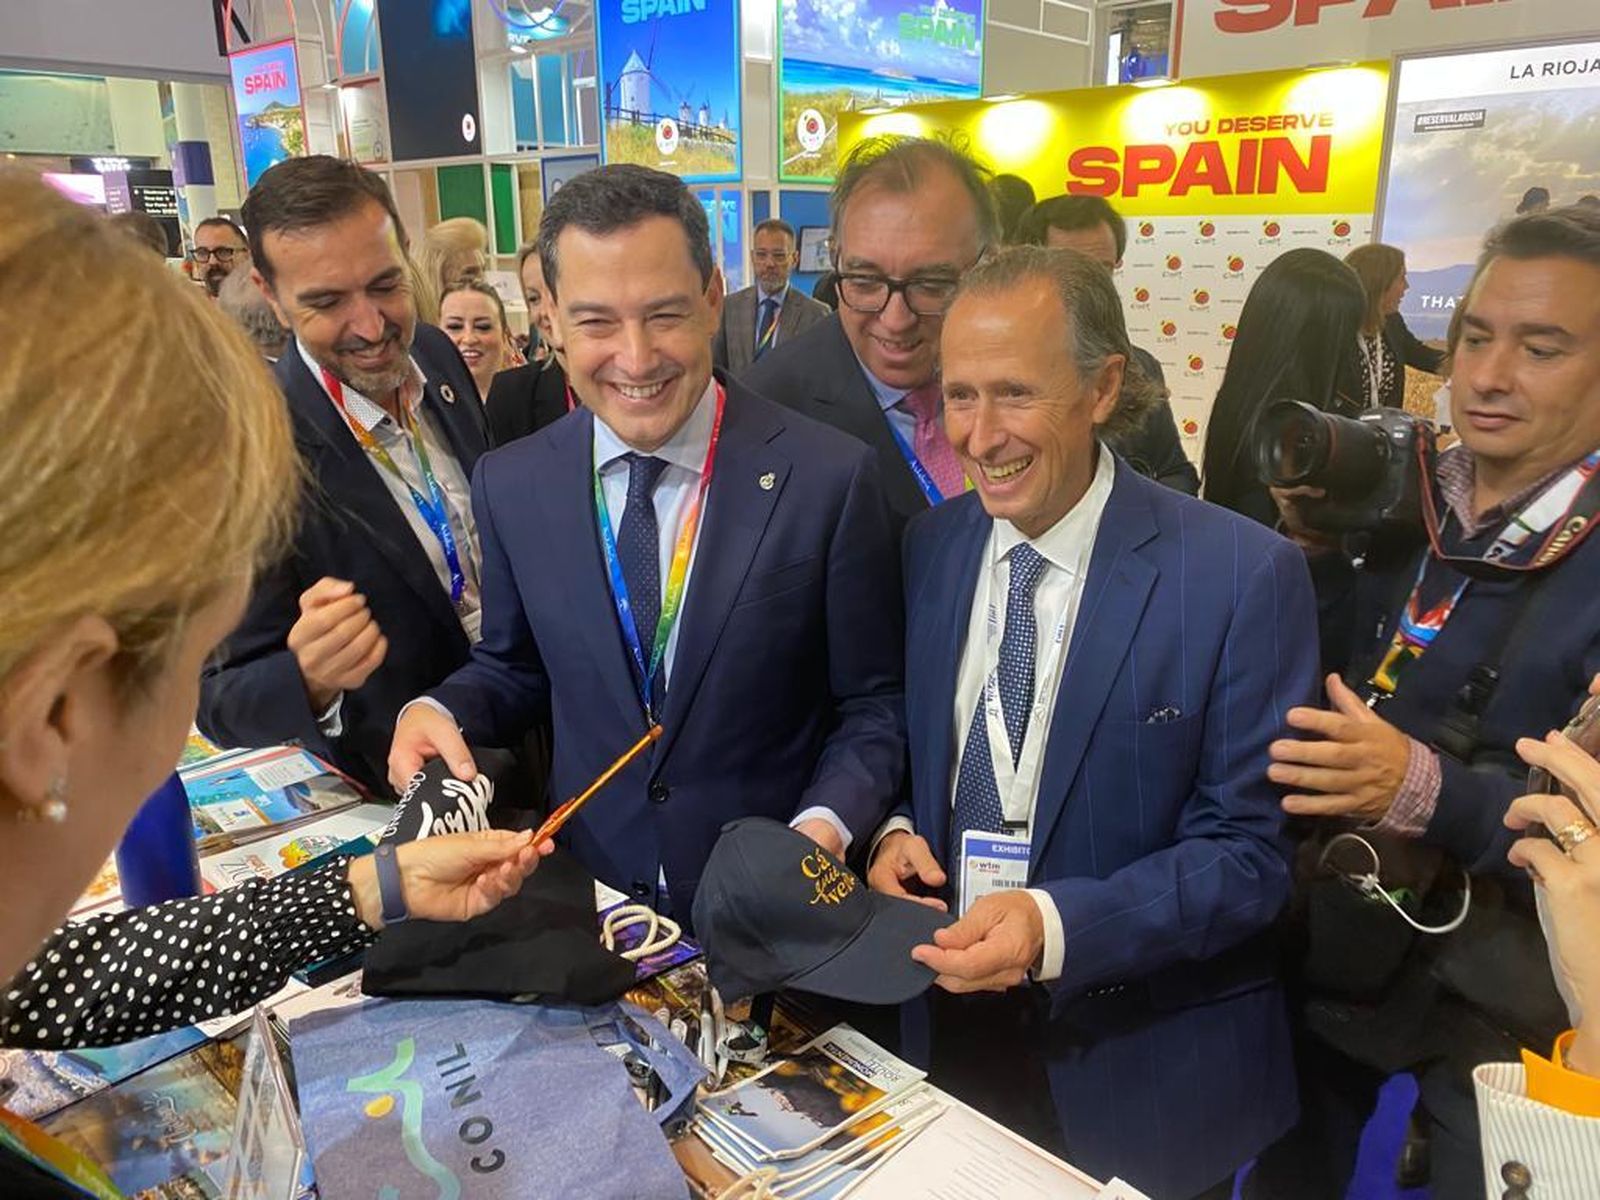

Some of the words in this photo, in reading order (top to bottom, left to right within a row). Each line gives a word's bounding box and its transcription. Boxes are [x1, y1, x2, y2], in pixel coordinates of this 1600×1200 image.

[1510, 64, 1535, 79] LA
[1542, 58, 1600, 76] RIOJA
[244, 72, 287, 95] SPAIN
[1165, 119, 1211, 136] YOU
[1216, 112, 1335, 134] DESERVE
[1065, 134, 1332, 198] SPAIN
[436, 1042, 506, 1175] CONIL
